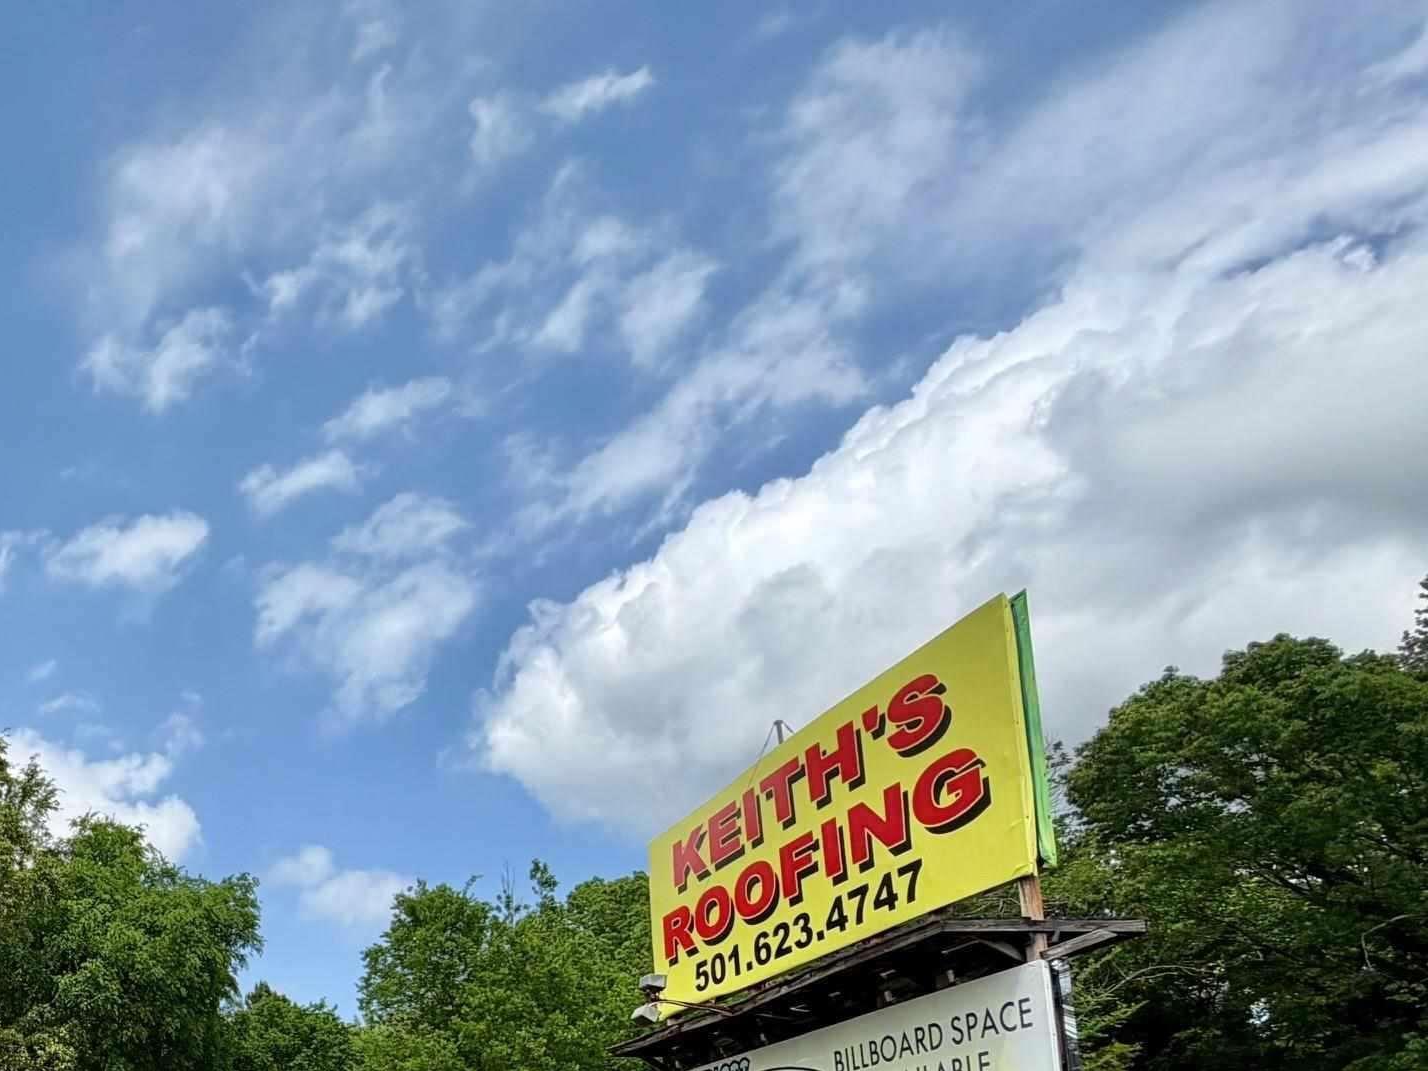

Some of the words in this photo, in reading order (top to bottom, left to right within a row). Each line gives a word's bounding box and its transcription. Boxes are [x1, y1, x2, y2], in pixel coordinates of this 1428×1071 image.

[662, 748, 991, 966] ROOFING
[672, 673, 951, 894] KEITH'S
[695, 858, 923, 992] 501.623.4747
[950, 997, 1034, 1046] SPACE
